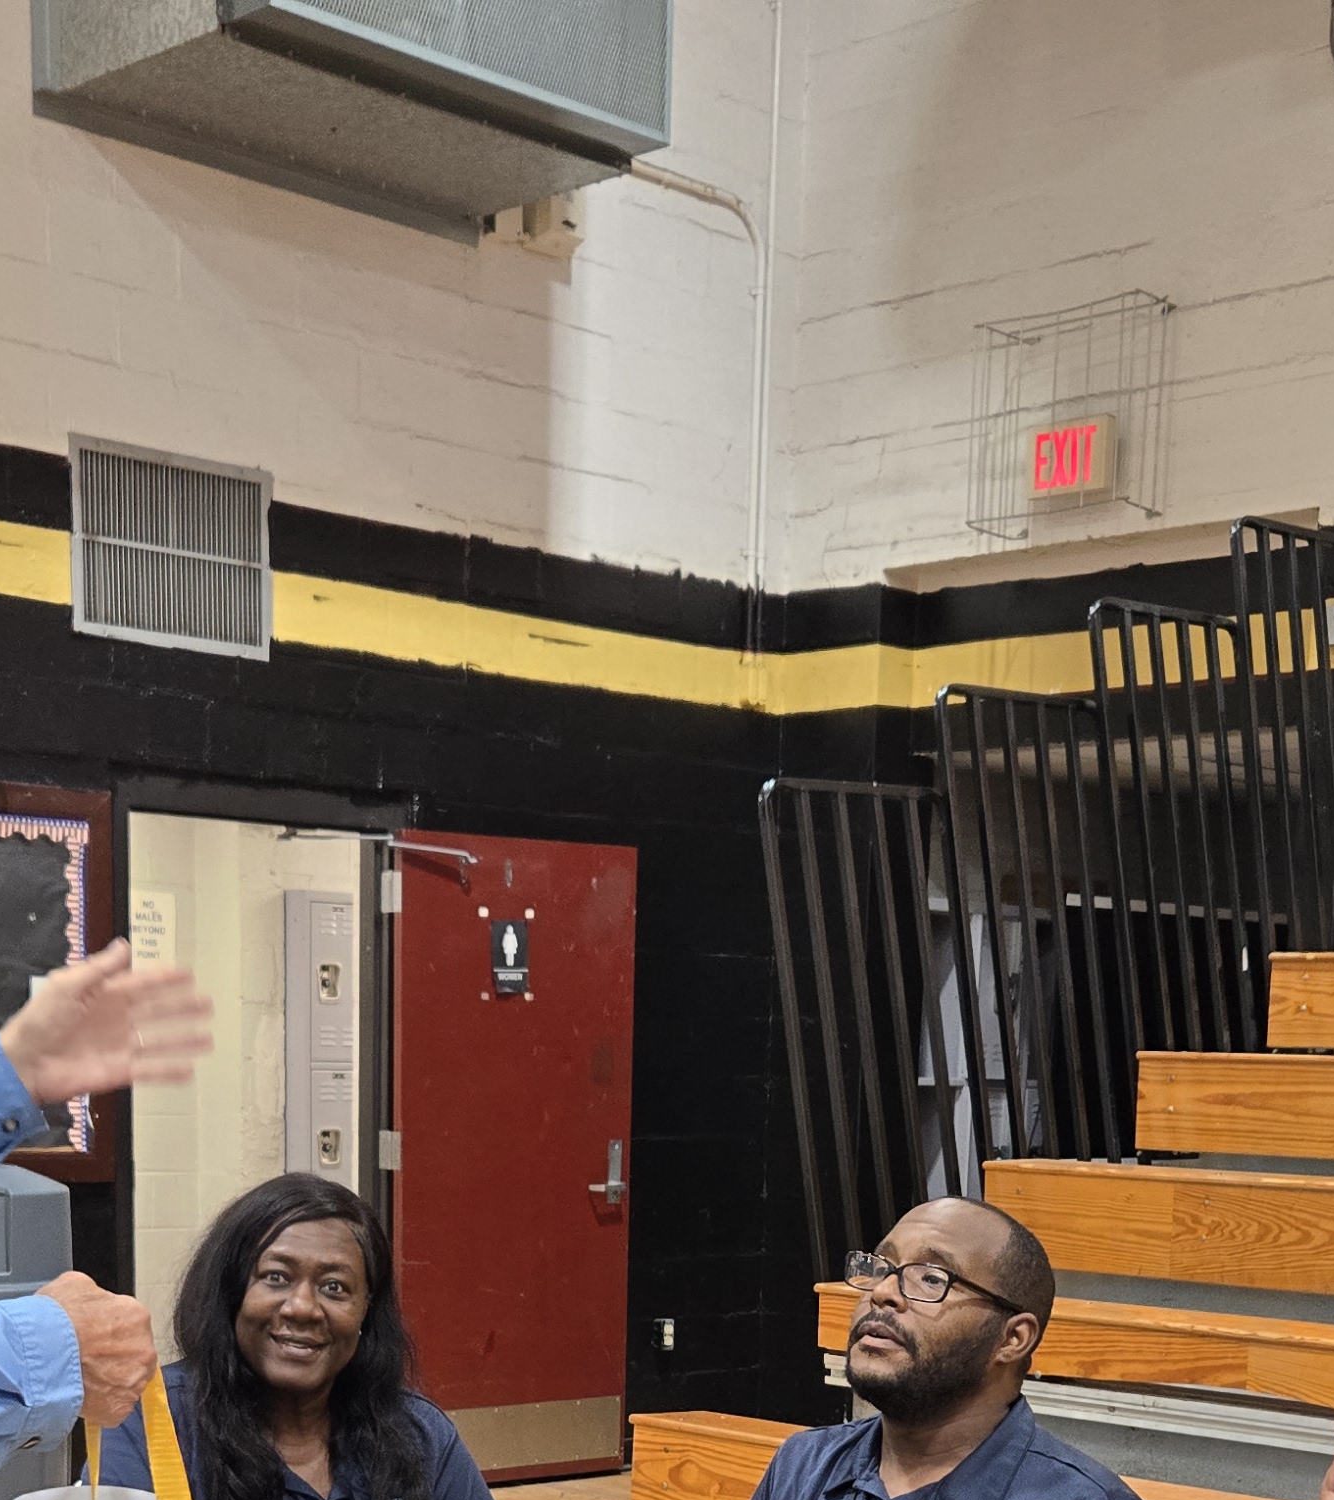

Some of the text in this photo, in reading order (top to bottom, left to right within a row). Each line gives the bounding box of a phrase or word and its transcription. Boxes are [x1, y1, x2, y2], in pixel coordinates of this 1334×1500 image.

[1034, 425, 1097, 490] EXIT
[142, 900, 155, 909] NO
[135, 911, 163, 922] MALES
[131, 924, 166, 935] BEYOND
[140, 938, 158, 947] THIS
